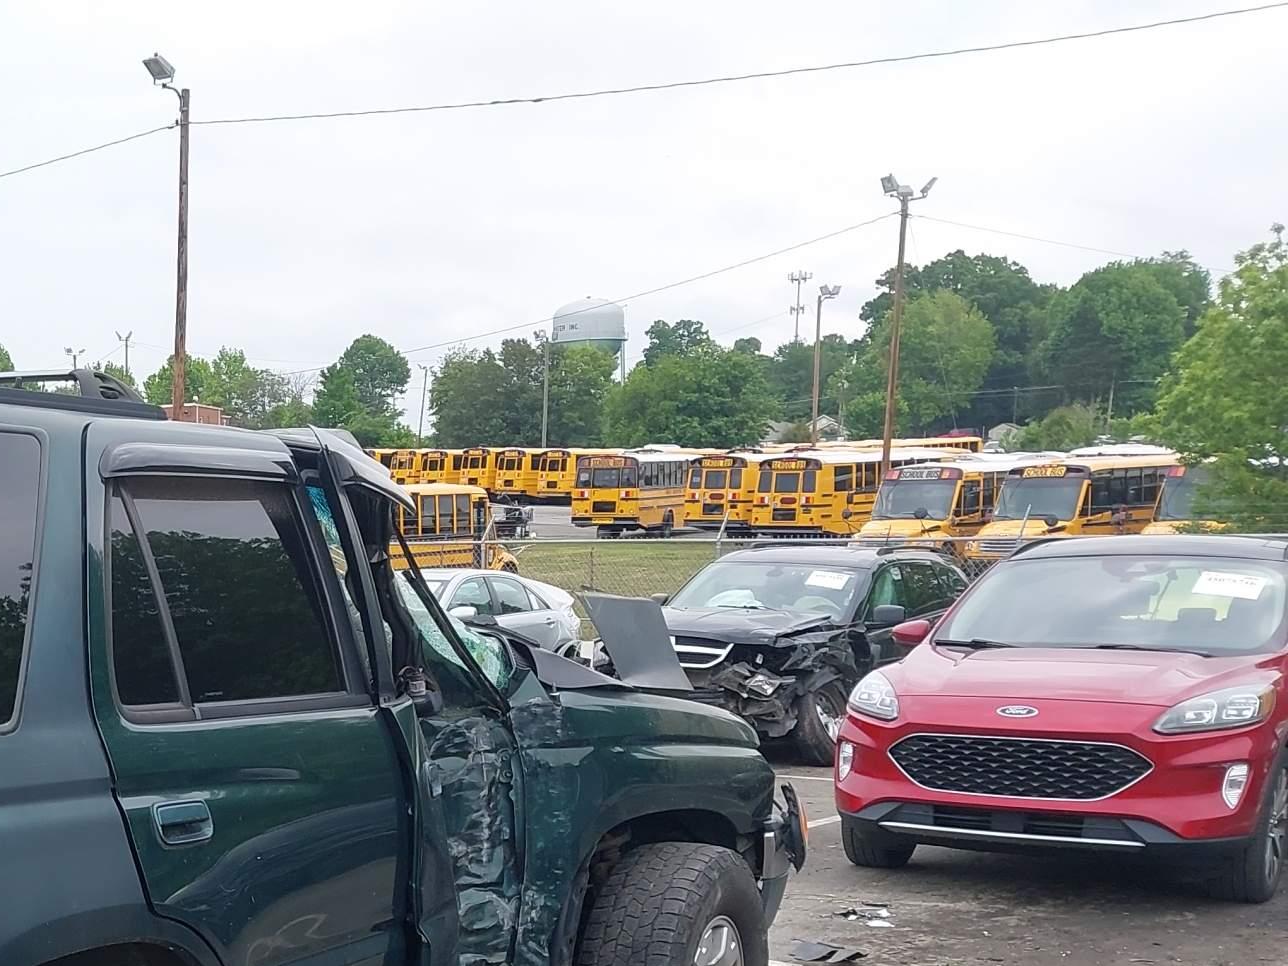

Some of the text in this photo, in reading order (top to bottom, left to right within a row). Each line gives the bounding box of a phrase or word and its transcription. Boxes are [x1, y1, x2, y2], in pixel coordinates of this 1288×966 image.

[901, 469, 940, 479] SCHOOL BUS
[1025, 467, 1065, 478] SCHOOL BUS
